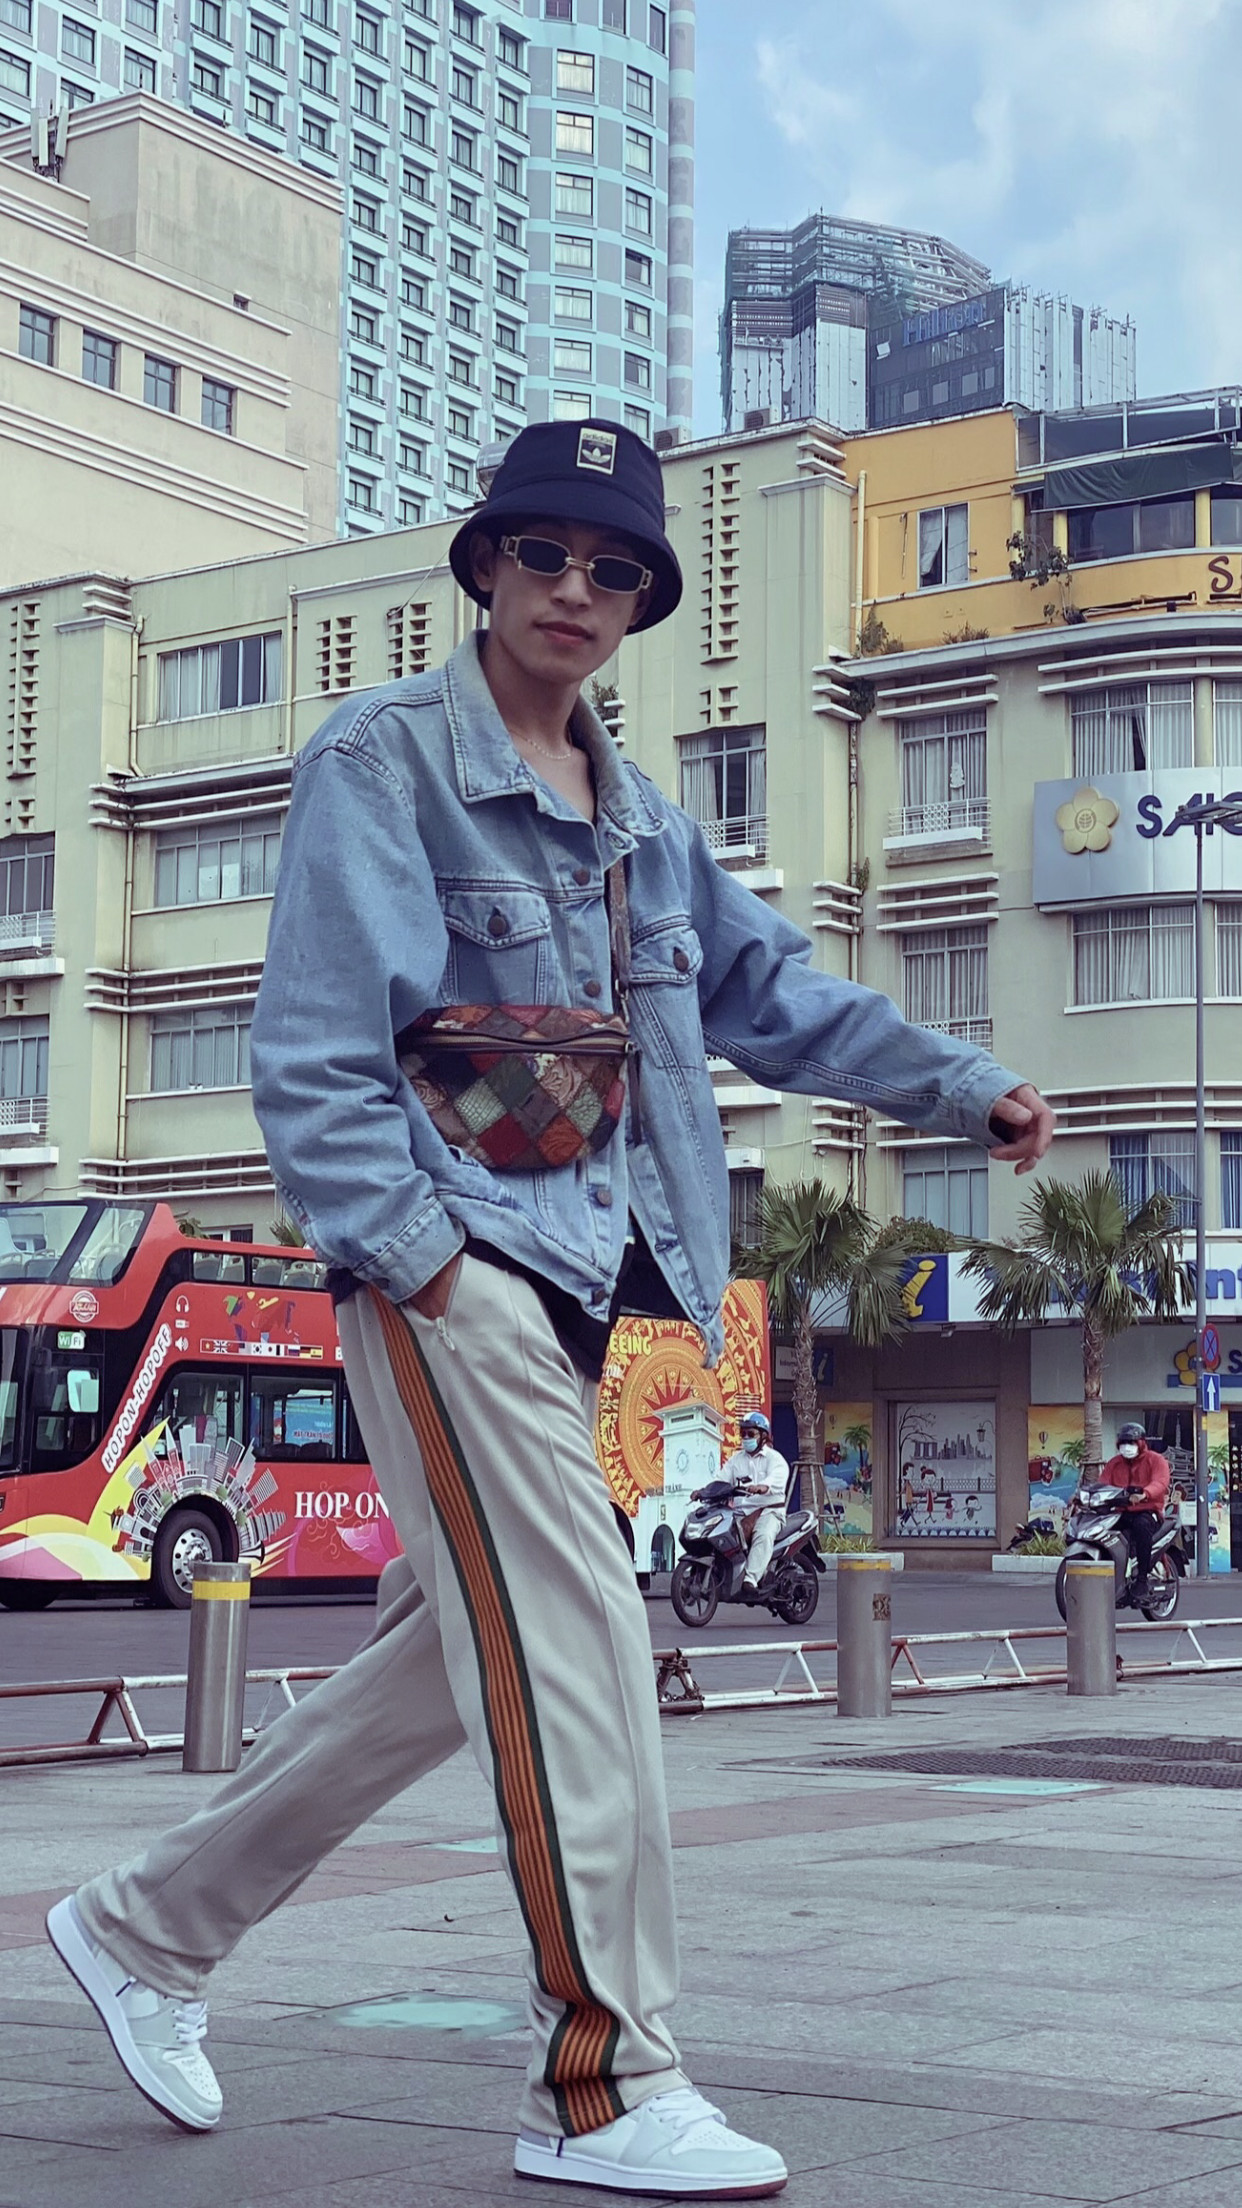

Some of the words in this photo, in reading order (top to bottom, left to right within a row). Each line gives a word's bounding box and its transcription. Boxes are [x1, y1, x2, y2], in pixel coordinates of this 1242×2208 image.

[902, 301, 985, 347] Hilton
[1208, 555, 1242, 592] S
[294, 1491, 350, 1518] HOP
